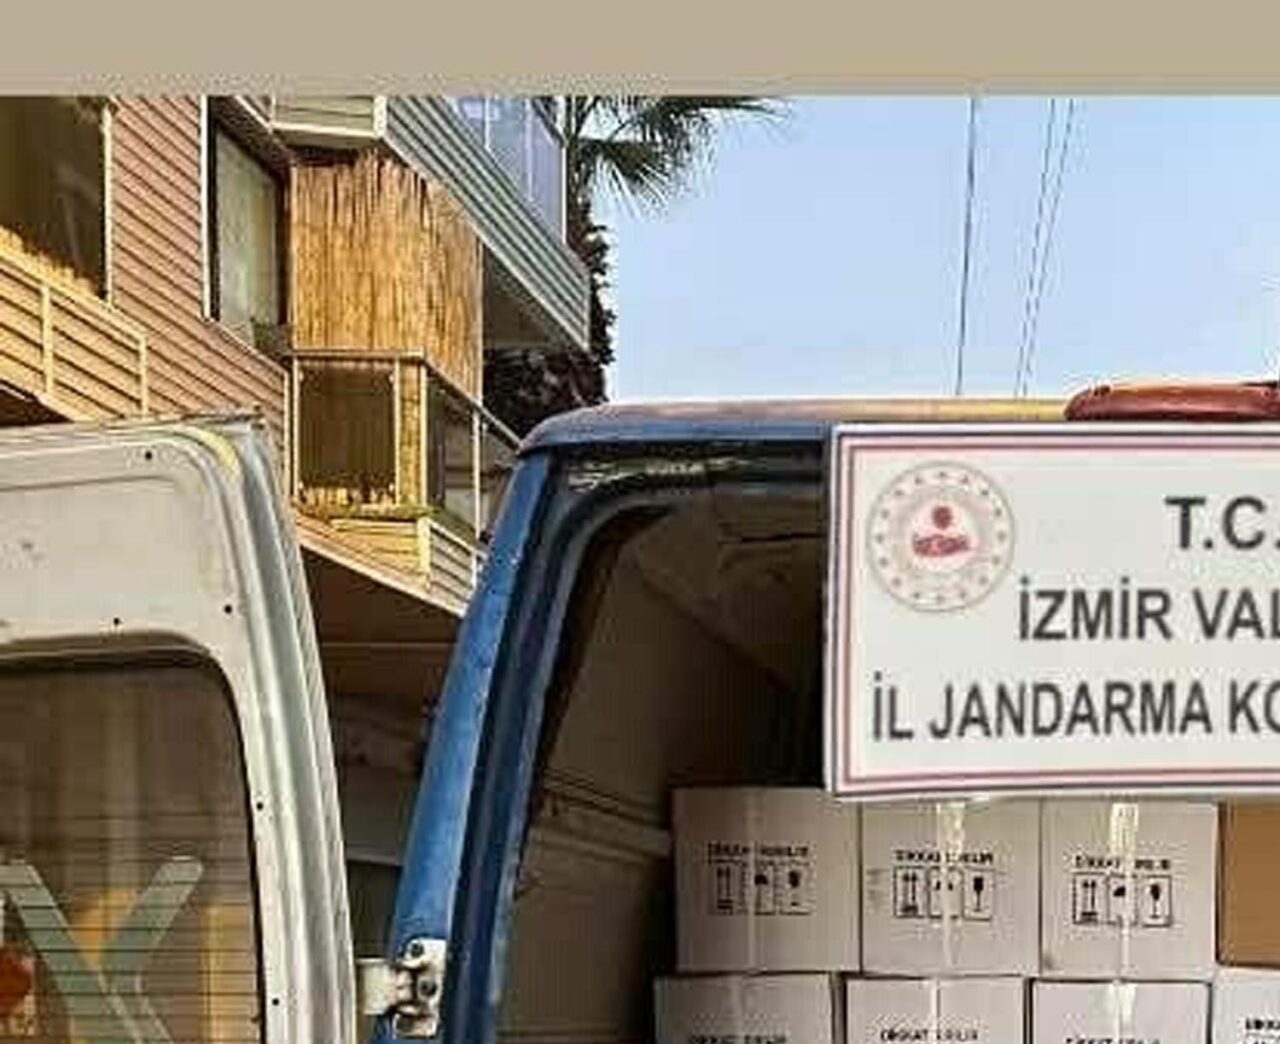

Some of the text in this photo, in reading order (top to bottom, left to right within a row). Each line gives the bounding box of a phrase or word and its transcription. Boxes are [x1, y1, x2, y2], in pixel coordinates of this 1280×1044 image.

[1017, 576, 1174, 641] İZMİR
[872, 670, 915, 741] İL
[928, 681, 1212, 741] JANDARMA
